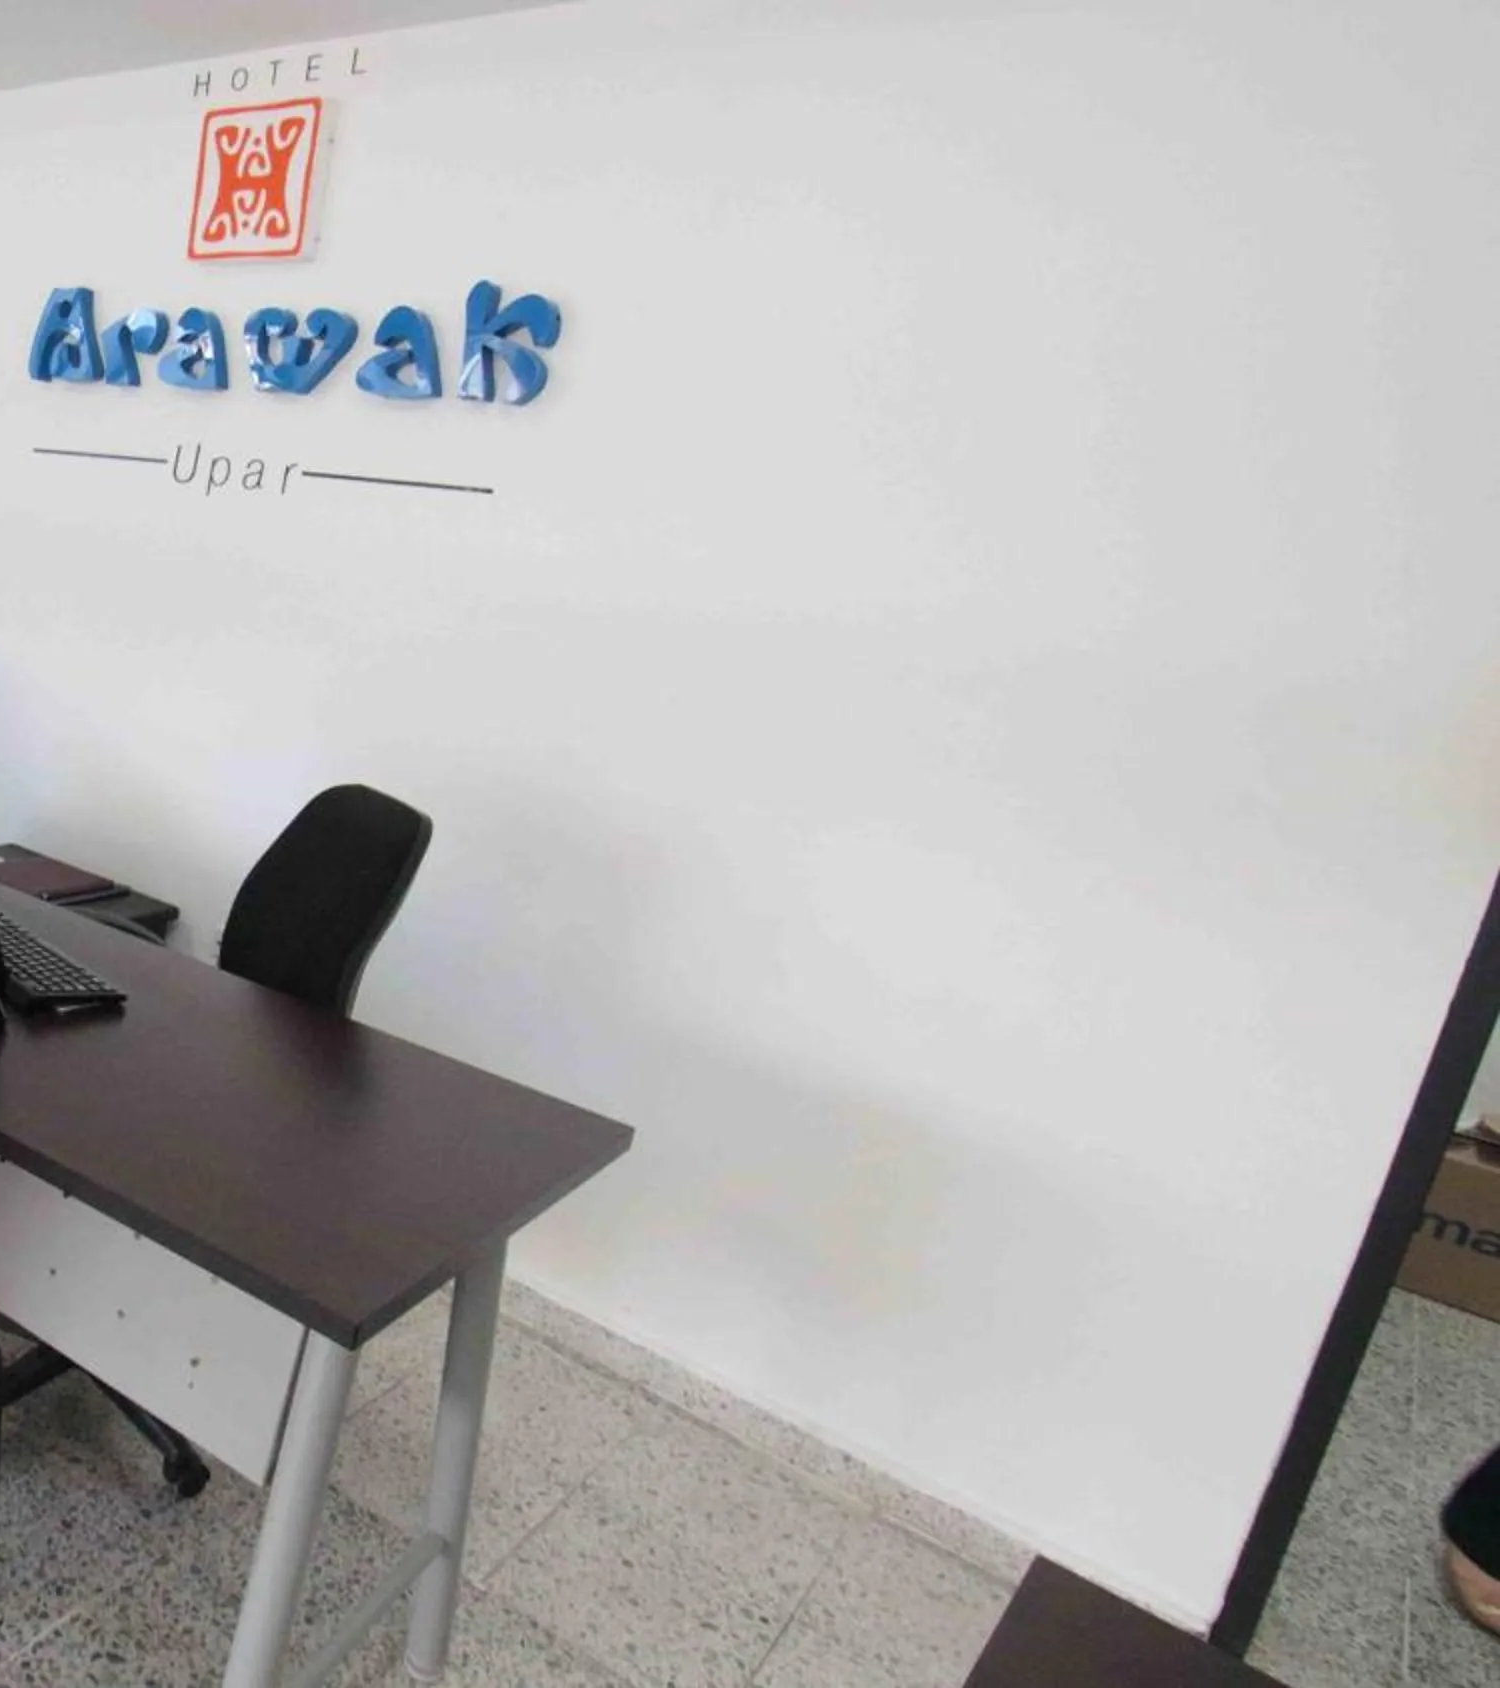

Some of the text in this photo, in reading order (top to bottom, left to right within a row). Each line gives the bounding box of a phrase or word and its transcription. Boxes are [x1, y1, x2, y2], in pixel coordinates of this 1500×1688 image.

[193, 47, 368, 97] HOTEL
[28, 279, 562, 406] Arawak
[172, 442, 299, 497] Upar
